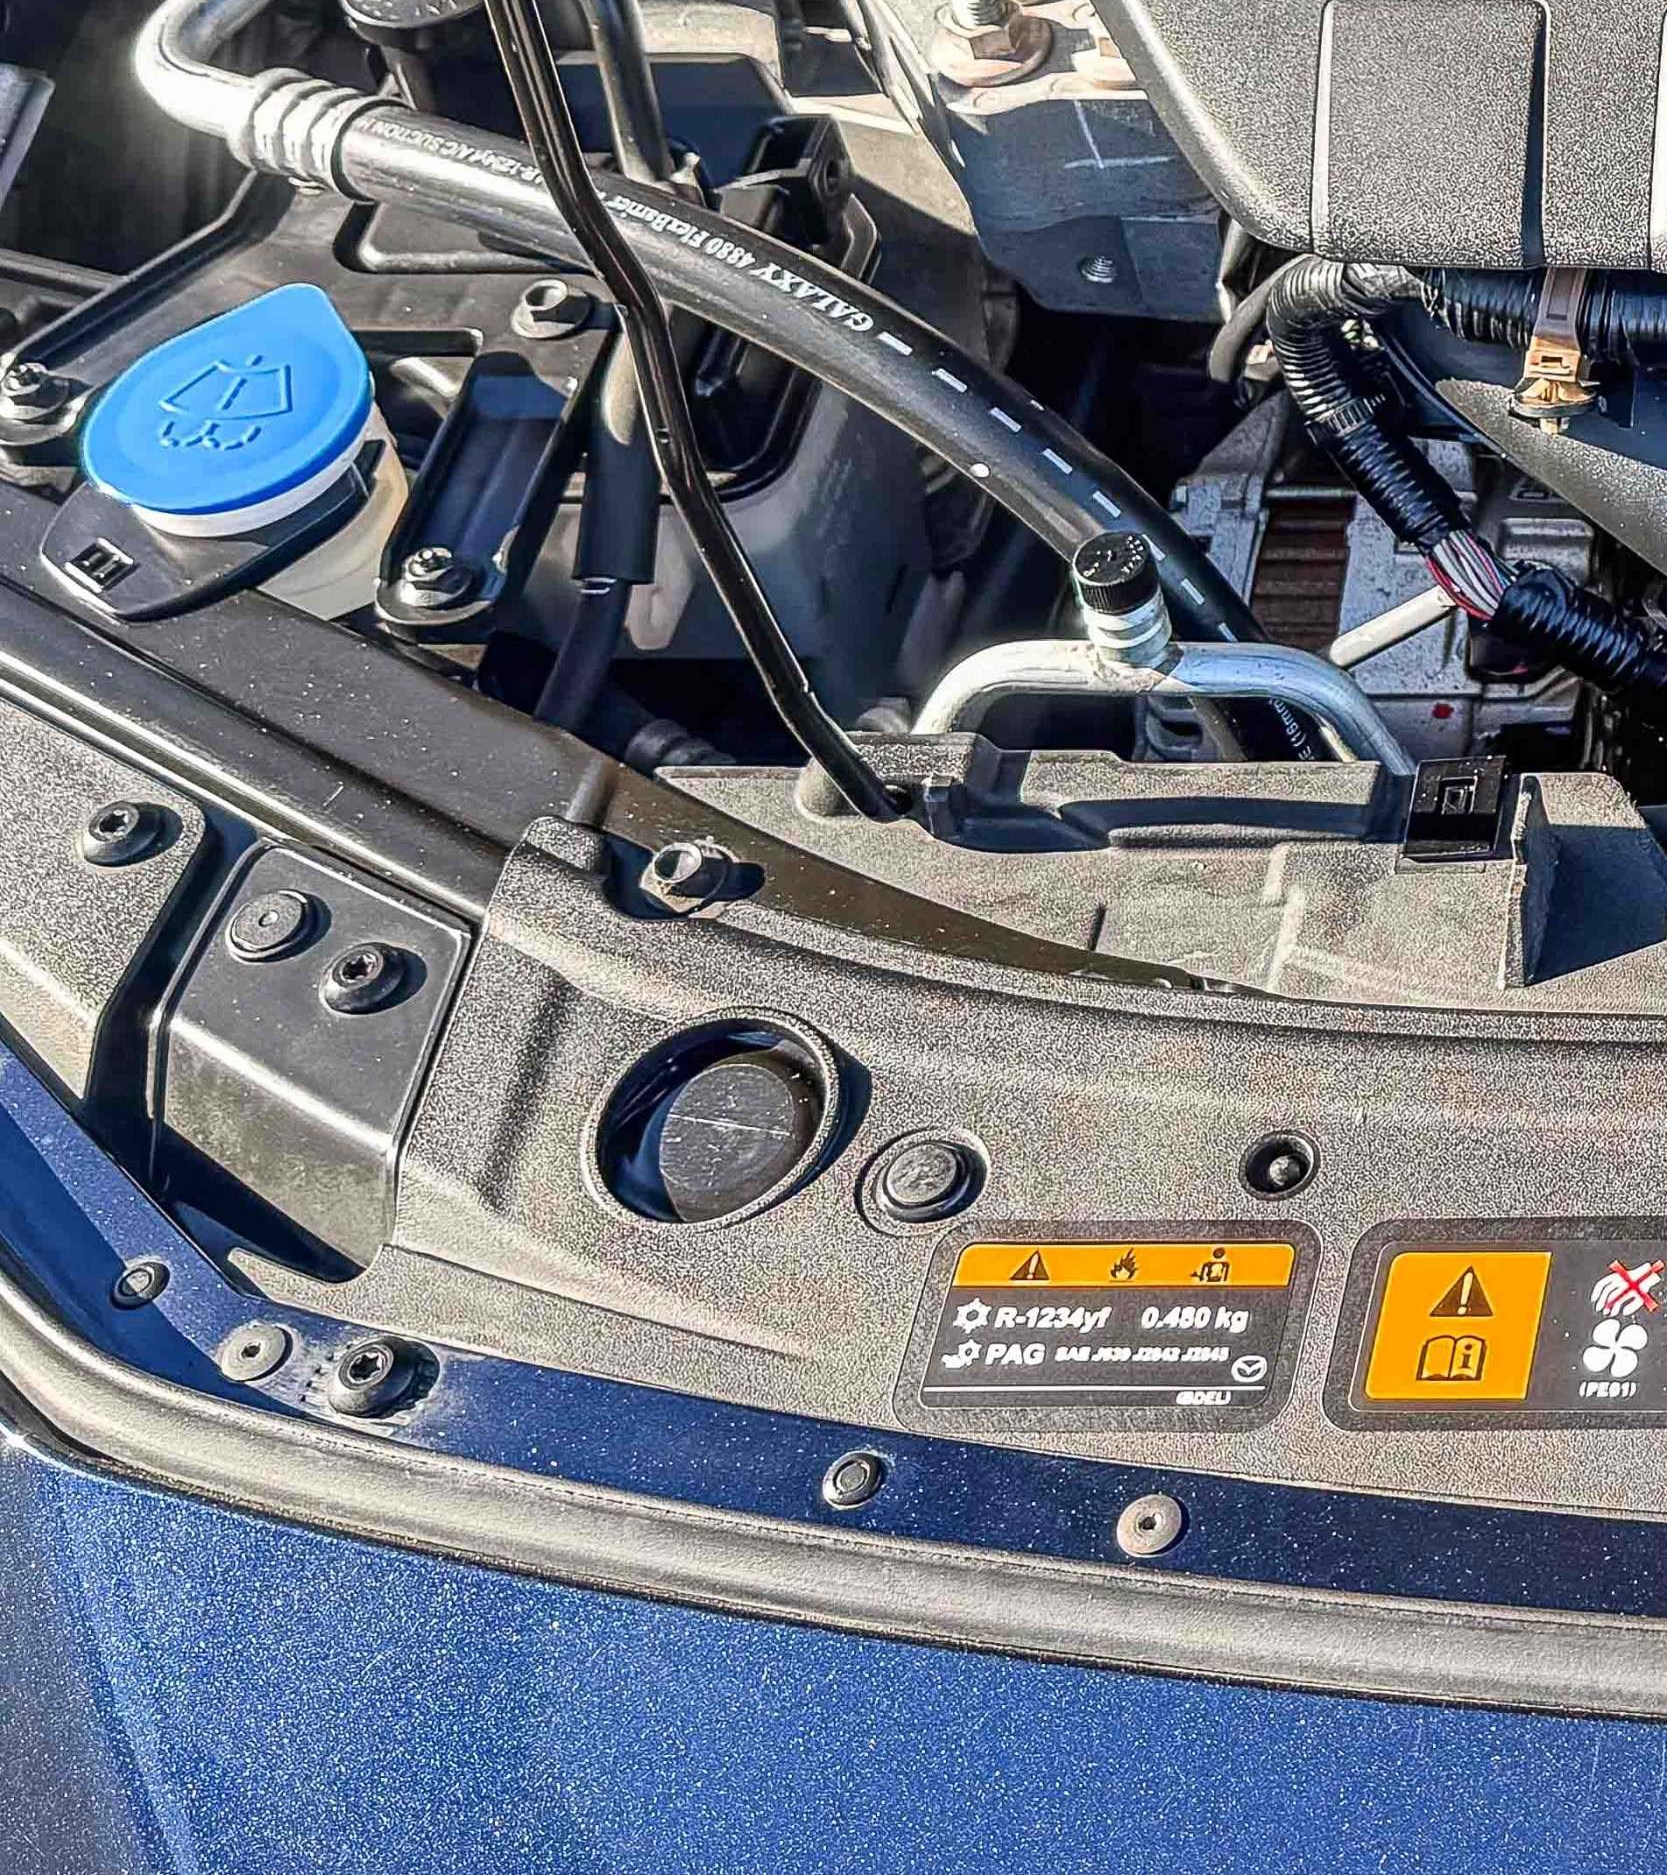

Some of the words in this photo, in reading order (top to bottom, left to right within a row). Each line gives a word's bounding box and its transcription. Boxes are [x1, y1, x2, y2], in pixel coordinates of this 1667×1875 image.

[370, 117, 445, 155] SUCTION
[607, 194, 711, 250] FlexBarrier
[705, 237, 756, 269] 4880
[752, 262, 875, 333] GALAXY
[994, 1306, 1113, 1334] R-1234yf
[1140, 1306, 1211, 1330] 0.480
[1214, 1306, 1250, 1334] kg
[984, 1342, 1047, 1366] PAG
[1054, 1346, 1092, 1363] SAE
